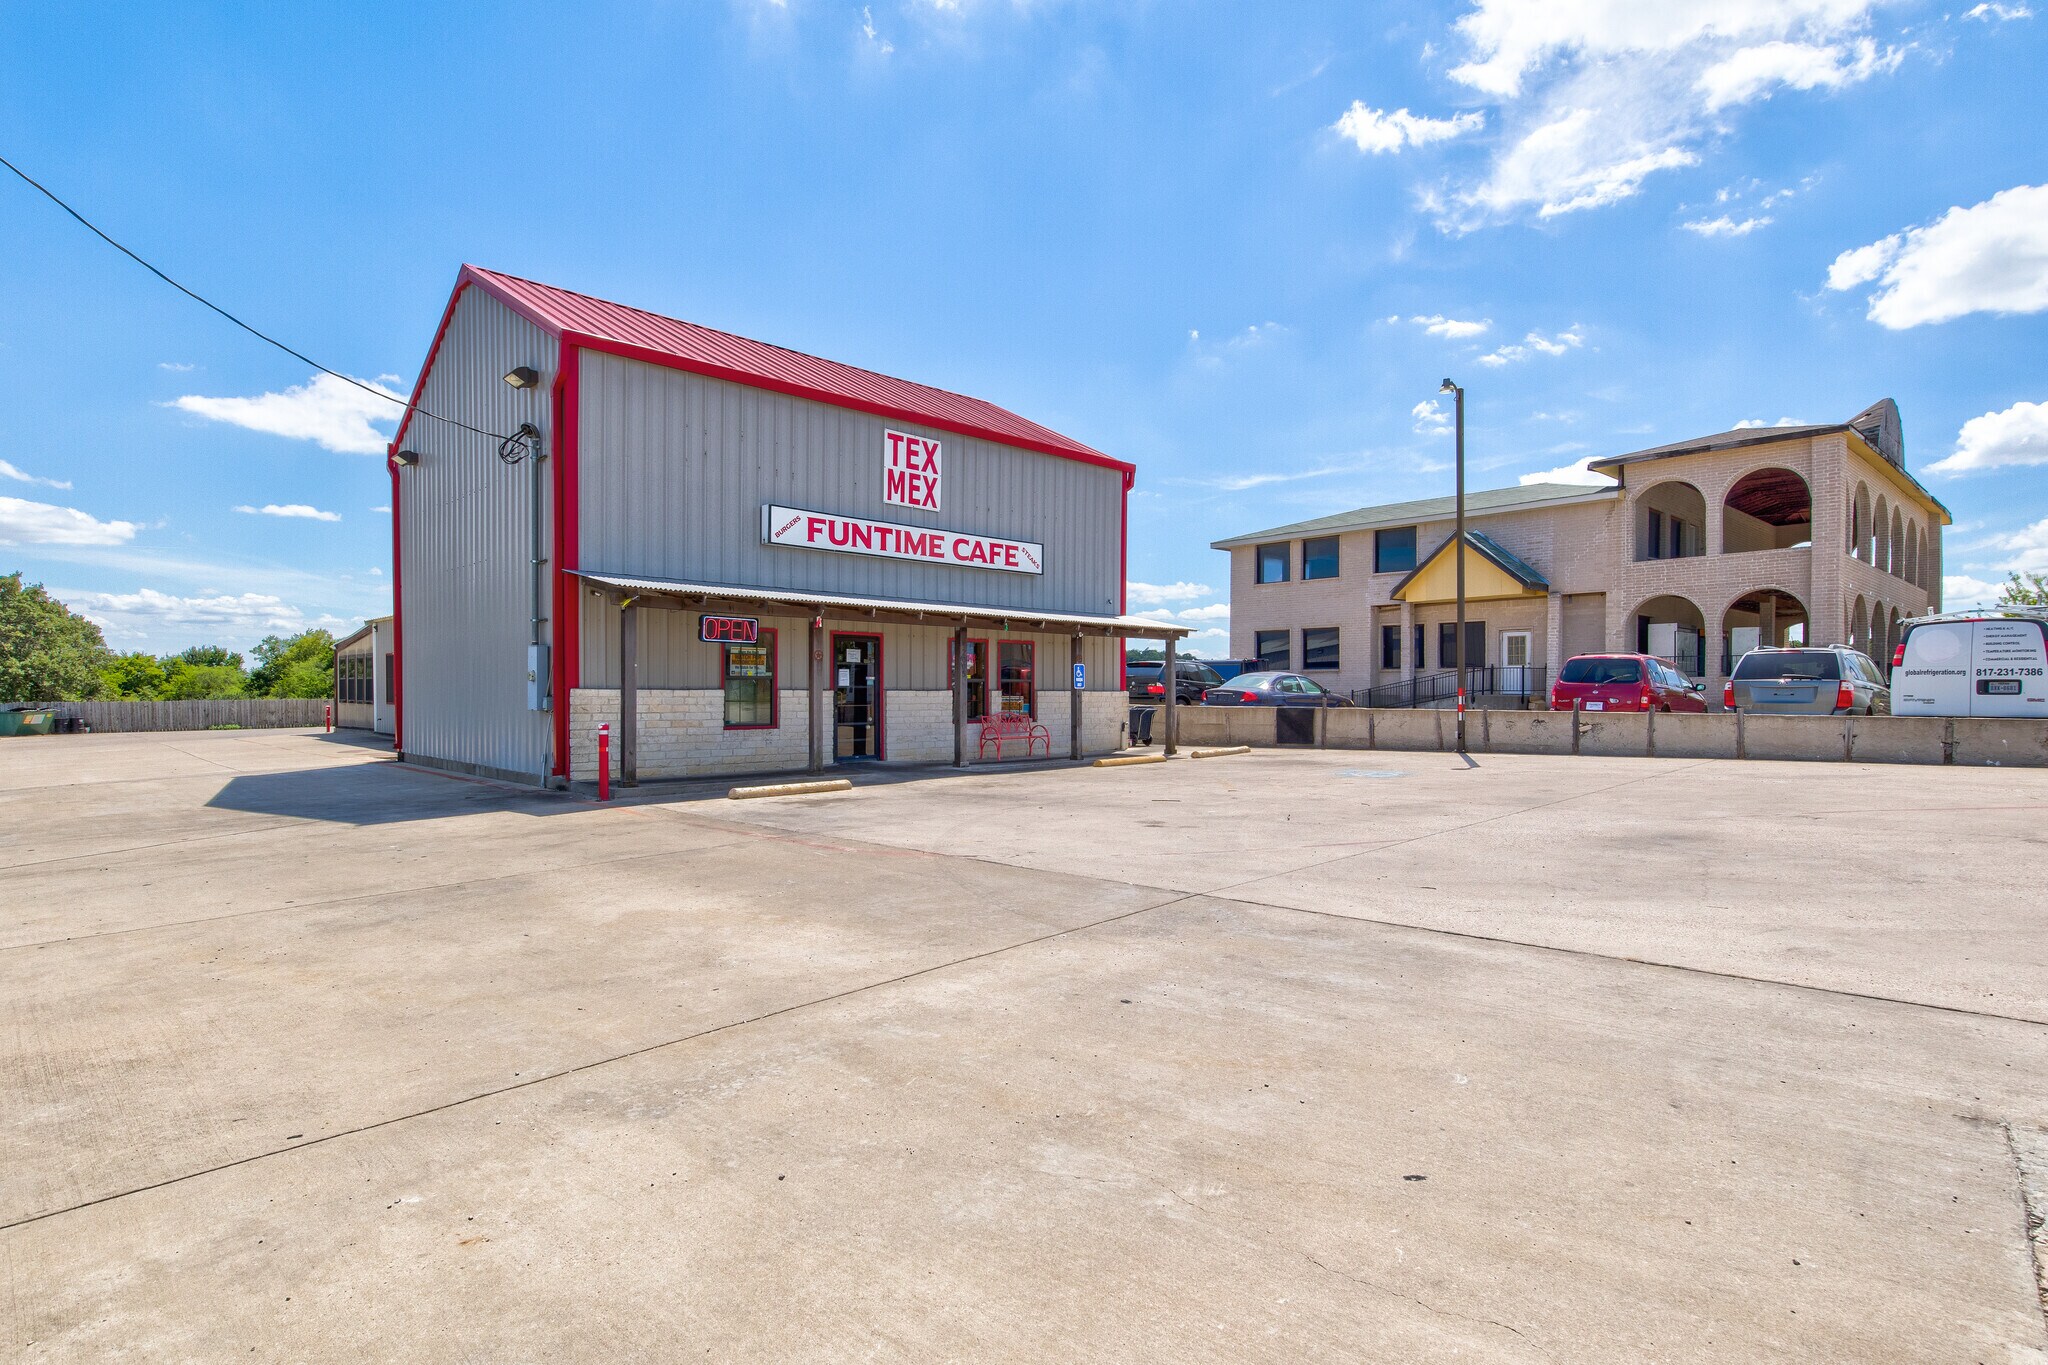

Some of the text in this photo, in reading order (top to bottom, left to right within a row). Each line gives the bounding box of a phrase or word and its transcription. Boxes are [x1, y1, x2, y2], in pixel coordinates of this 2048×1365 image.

[887, 432, 939, 475] TEX
[887, 469, 938, 509] MEX
[774, 515, 801, 539] BURGERS
[806, 516, 1019, 567] FUNTIME CAFE
[1021, 547, 1040, 570] STEAKS
[705, 619, 757, 641] OPEN
[1905, 669, 1966, 677] globalrefrigeration.org
[1976, 668, 2043, 676] 817-231-7386
